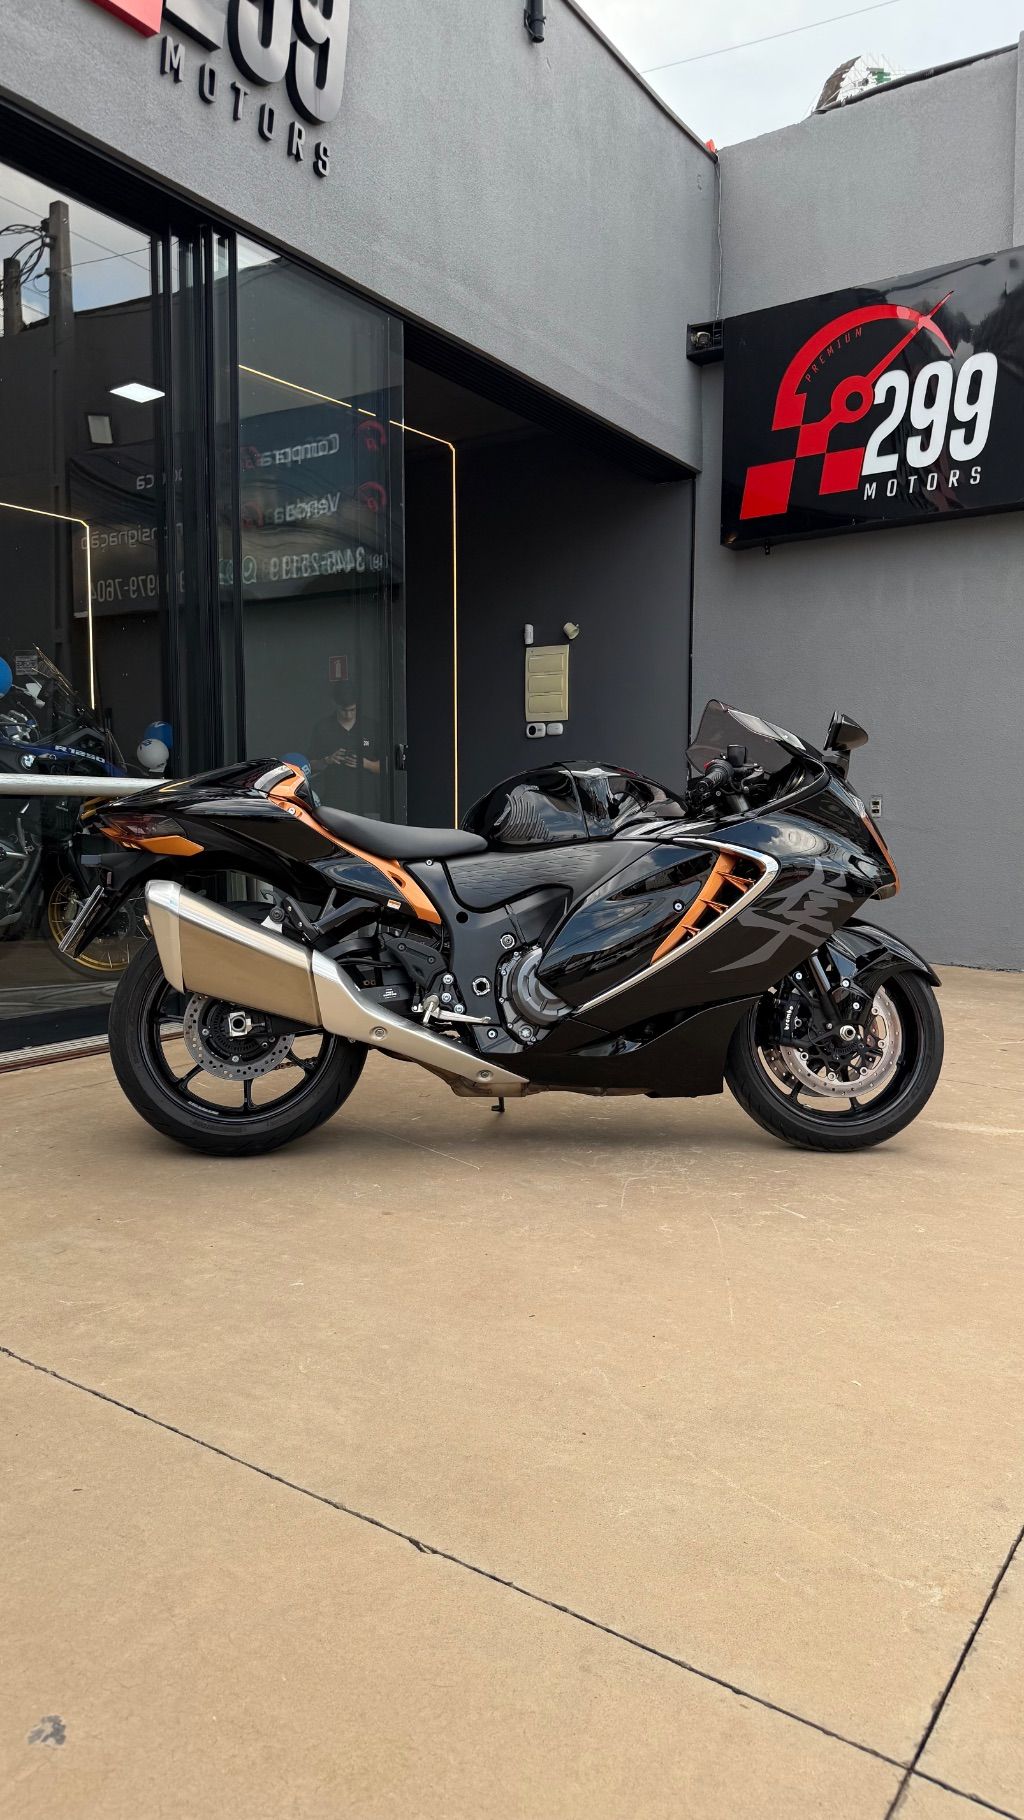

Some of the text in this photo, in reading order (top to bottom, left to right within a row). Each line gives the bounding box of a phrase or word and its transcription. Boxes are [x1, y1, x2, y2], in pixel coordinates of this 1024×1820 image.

[160, 35, 331, 178] MOTORS
[805, 327, 862, 383] PREMIUM
[861, 352, 998, 476] 299
[863, 466, 982, 501] MOTORS
[783, 1005, 794, 1031] brembo
